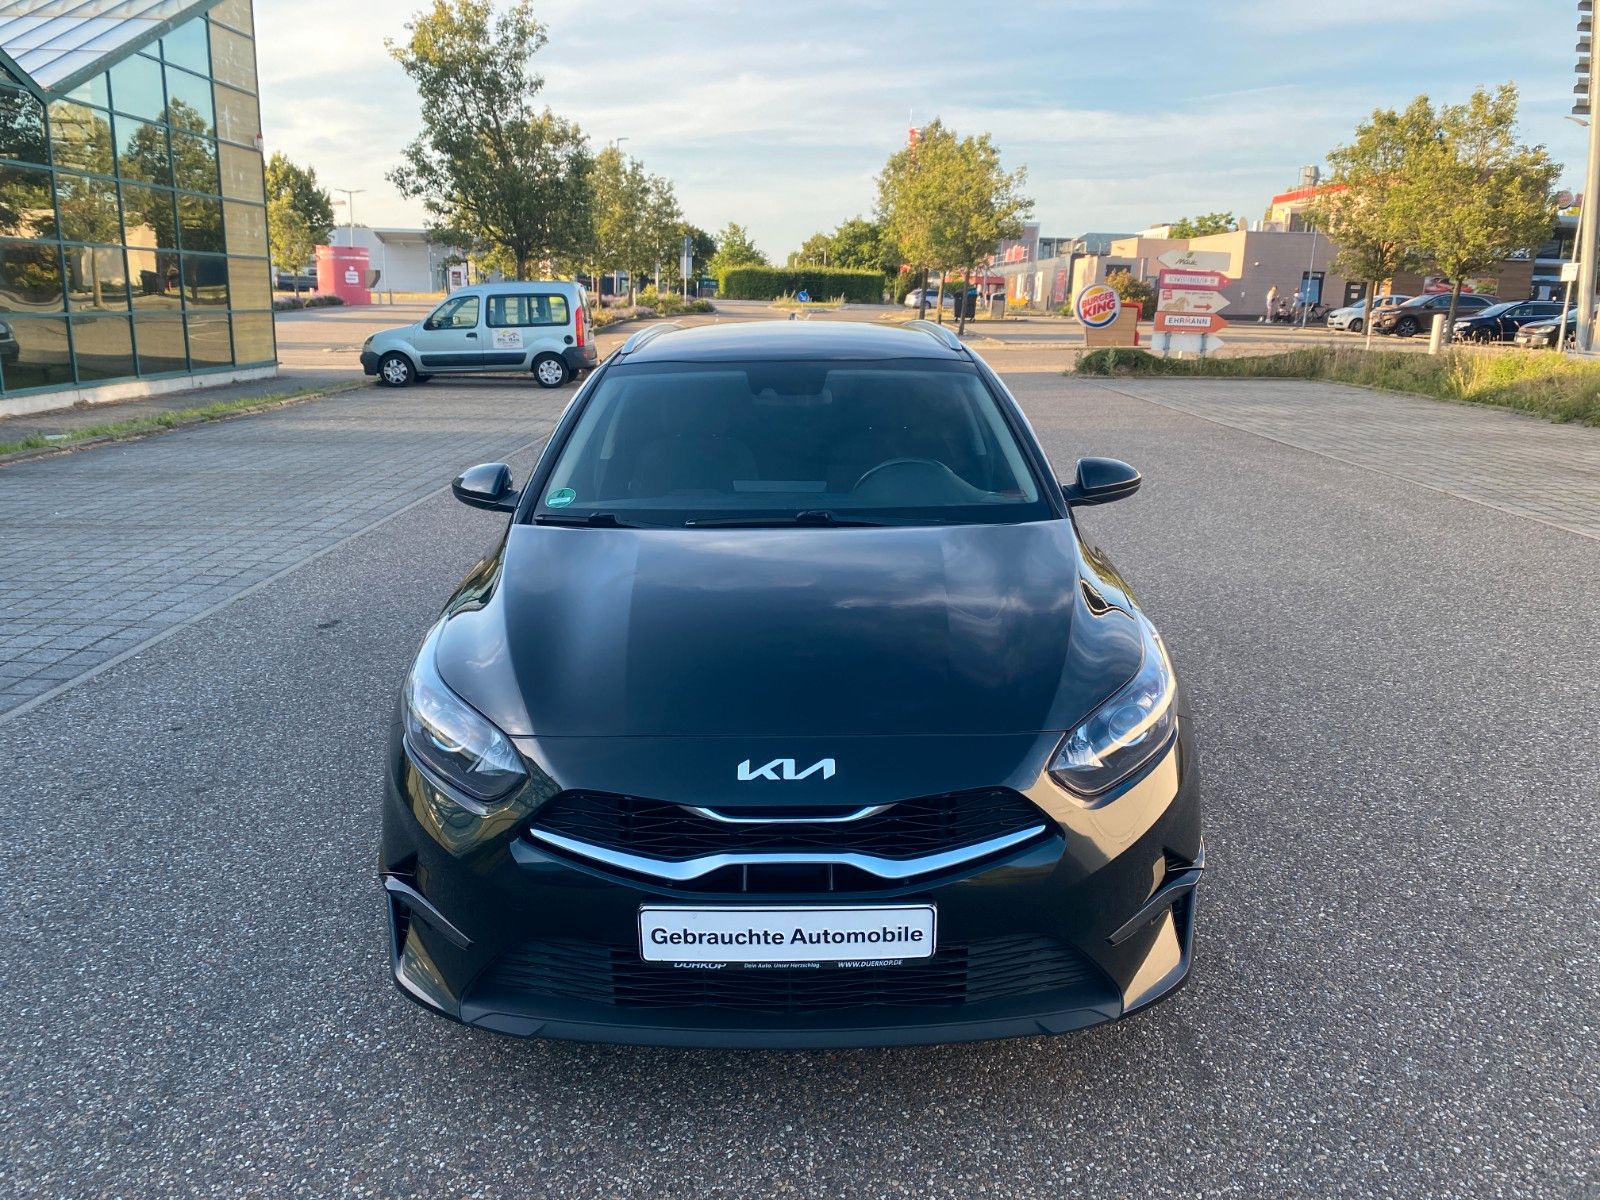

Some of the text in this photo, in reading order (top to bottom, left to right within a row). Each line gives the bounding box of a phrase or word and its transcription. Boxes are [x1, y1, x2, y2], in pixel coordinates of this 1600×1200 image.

[1082, 291, 1115, 308] BURGER
[1083, 299, 1116, 319] KING
[1168, 317, 1208, 325] EHRMANN
[737, 758, 836, 781] KIA
[651, 925, 924, 945] Gebrauchte Automobile
[837, 959, 903, 968] WWW.DUERKOP.DE
